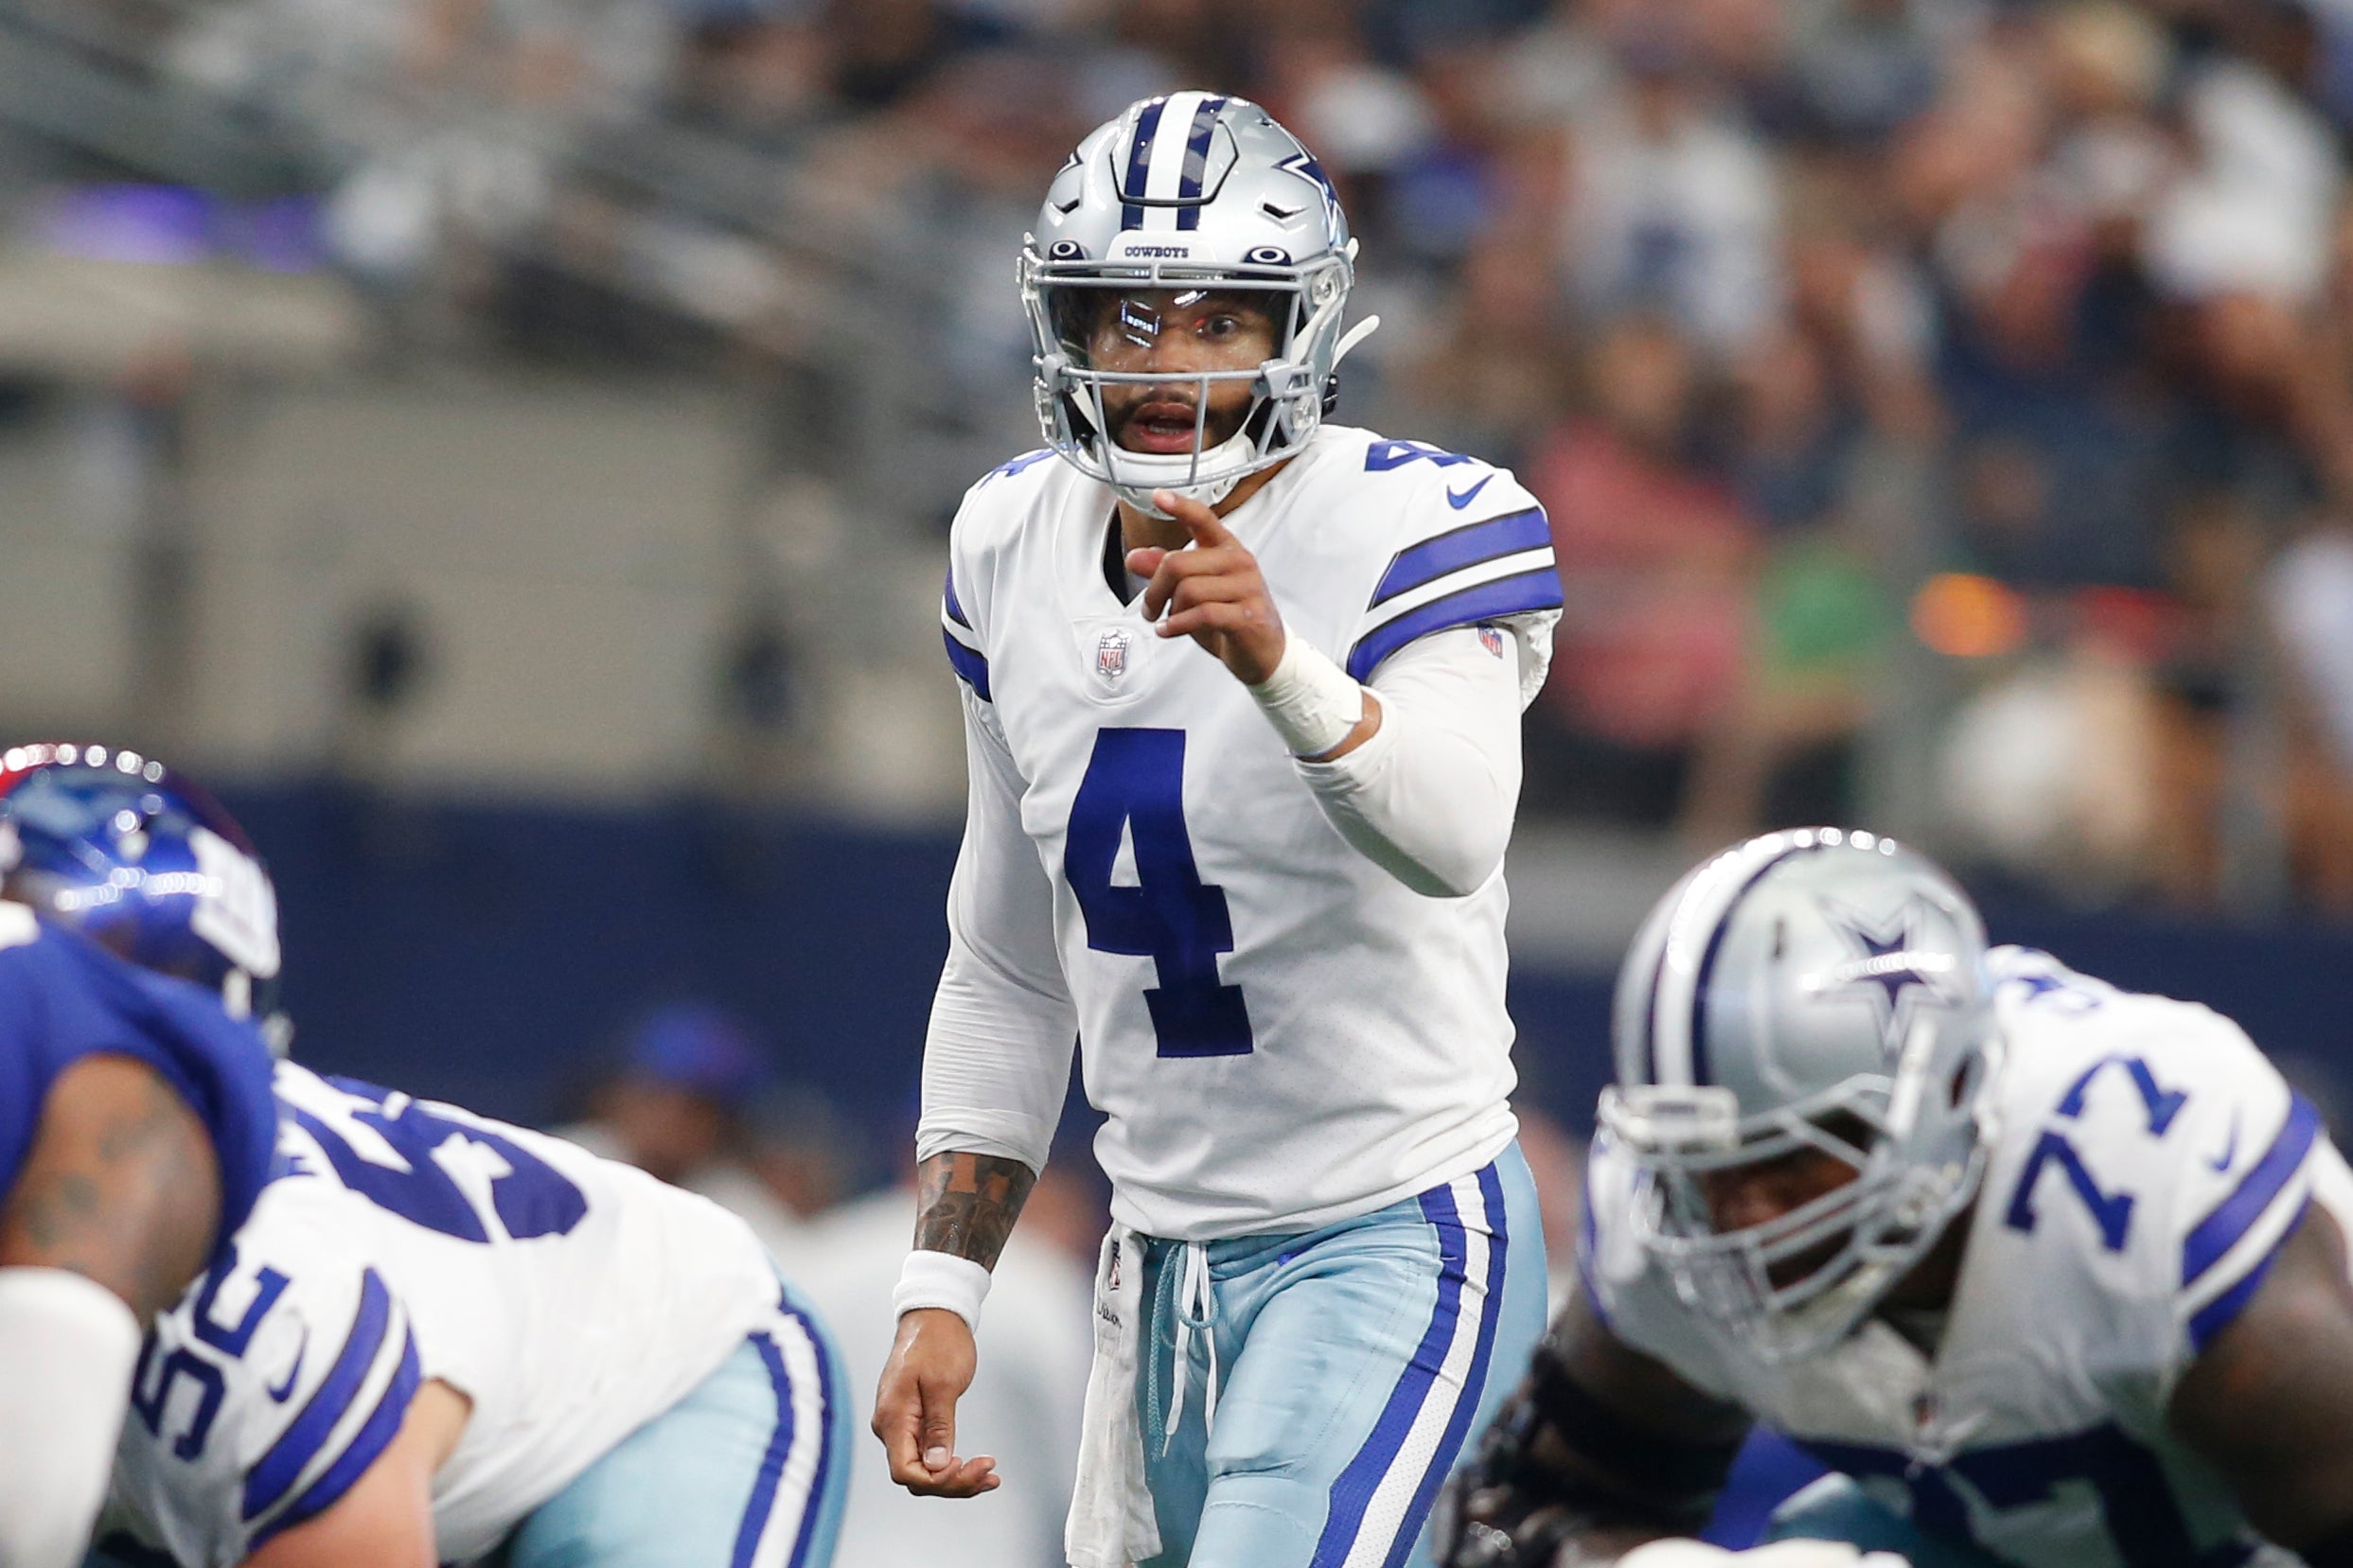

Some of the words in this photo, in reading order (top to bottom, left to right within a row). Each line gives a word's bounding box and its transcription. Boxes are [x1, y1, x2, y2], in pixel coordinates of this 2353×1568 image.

[1124, 246, 1189, 258] COWBOYS
[1100, 650, 1122, 669] NFL
[1064, 728, 1253, 1058] 4
[2006, 1055, 2190, 1254] 77
